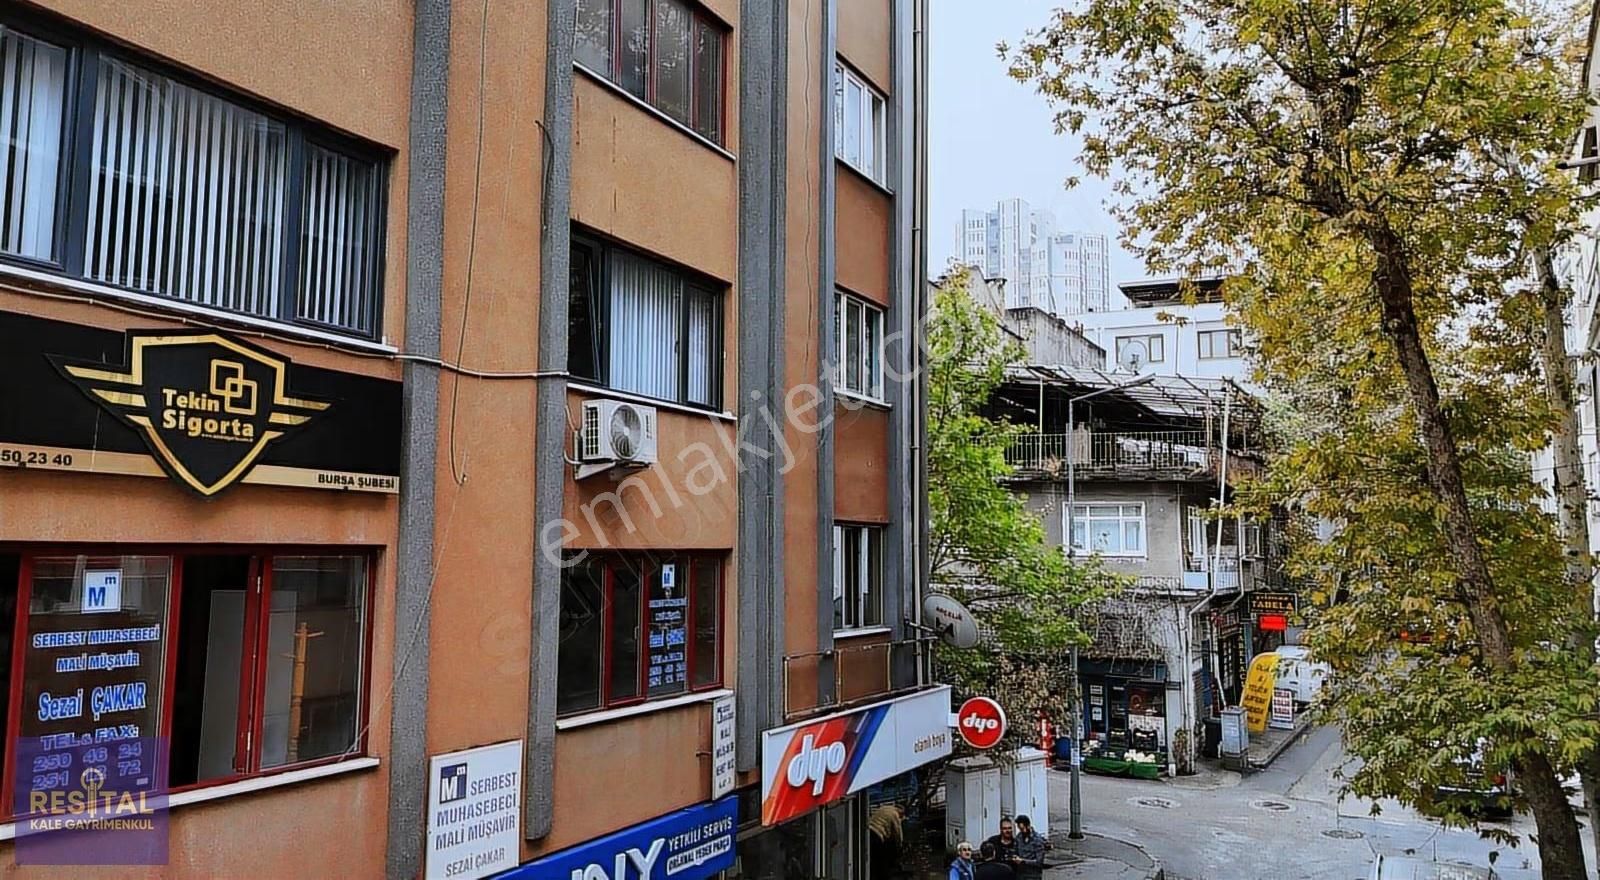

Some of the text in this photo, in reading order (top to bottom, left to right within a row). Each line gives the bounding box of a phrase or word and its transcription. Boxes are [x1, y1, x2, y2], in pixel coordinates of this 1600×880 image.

[162, 388, 220, 412] Tekin
[162, 408, 254, 437] Sigorta
[27, 451, 48, 465] 23
[52, 453, 73, 466] 40
[318, 473, 395, 489] BURSA ŞUBESİ
[1251, 600, 1295, 610] TABELA
[33, 623, 161, 649] SERBEST MUHASEBECİ
[56, 649, 140, 673] MALİ MÜŞAVİR
[38, 682, 147, 722] Sezai ÇAKAR
[962, 712, 999, 733] dyo
[33, 741, 143, 774] 250 46 24
[786, 733, 846, 797] dyo
[32, 770, 70, 791] 251
[117, 759, 142, 776] 72
[470, 772, 518, 797] SERBEST
[436, 788, 517, 828] MUHASEBECİ
[435, 811, 516, 851] MALİ MÜŞAVİR
[668, 815, 733, 852] YETKİLİ SERVİS
[445, 847, 506, 878] SEZAİ ÇAKAR
